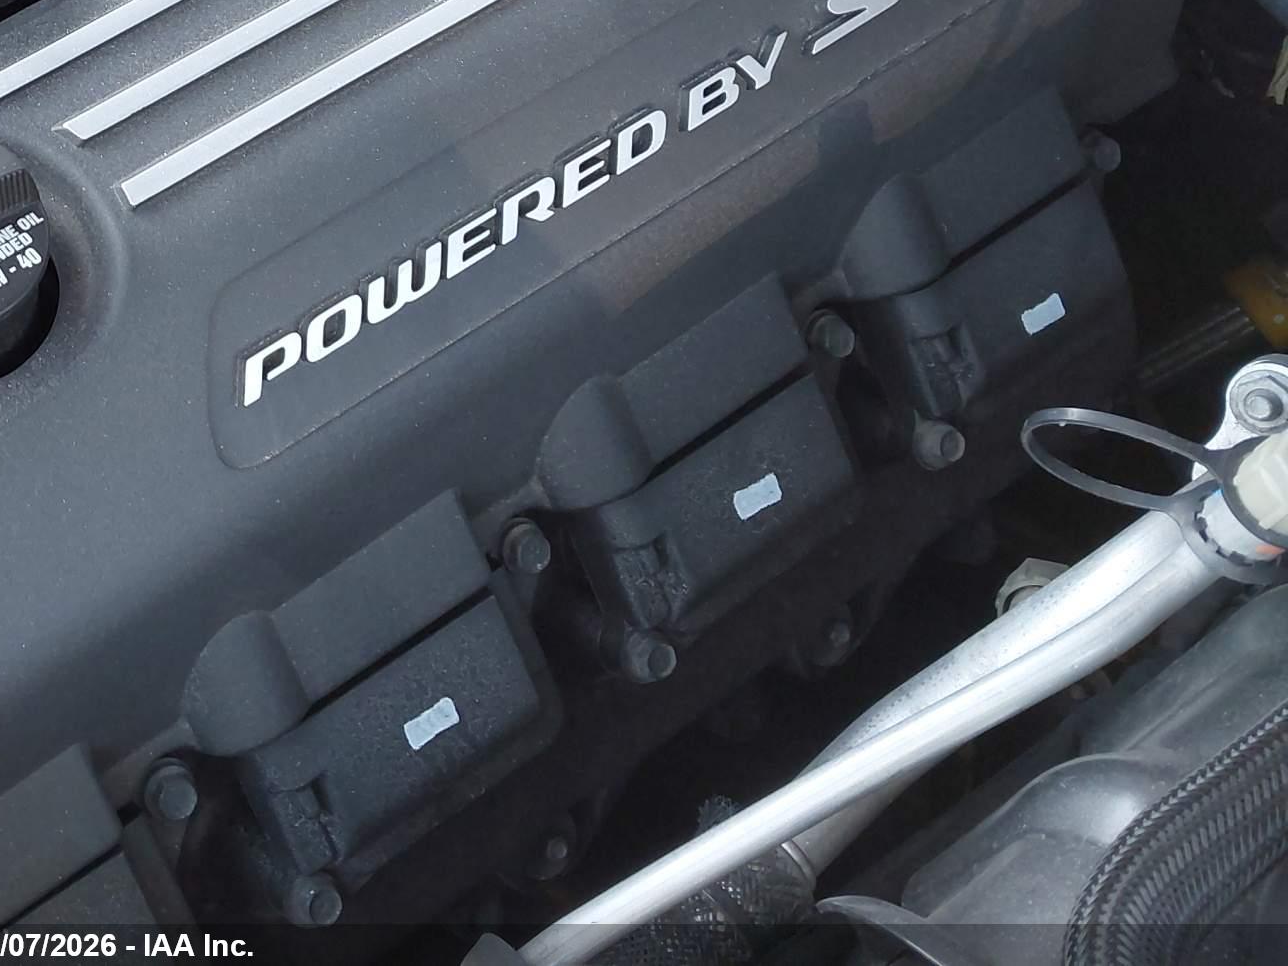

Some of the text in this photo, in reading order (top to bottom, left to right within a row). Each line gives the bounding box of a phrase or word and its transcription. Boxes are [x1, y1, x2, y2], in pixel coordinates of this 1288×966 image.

[16, 212, 44, 231] OIL
[242, 109, 667, 408] POWERED
[687, 31, 788, 132] BY
[16, 247, 42, 269] 40
